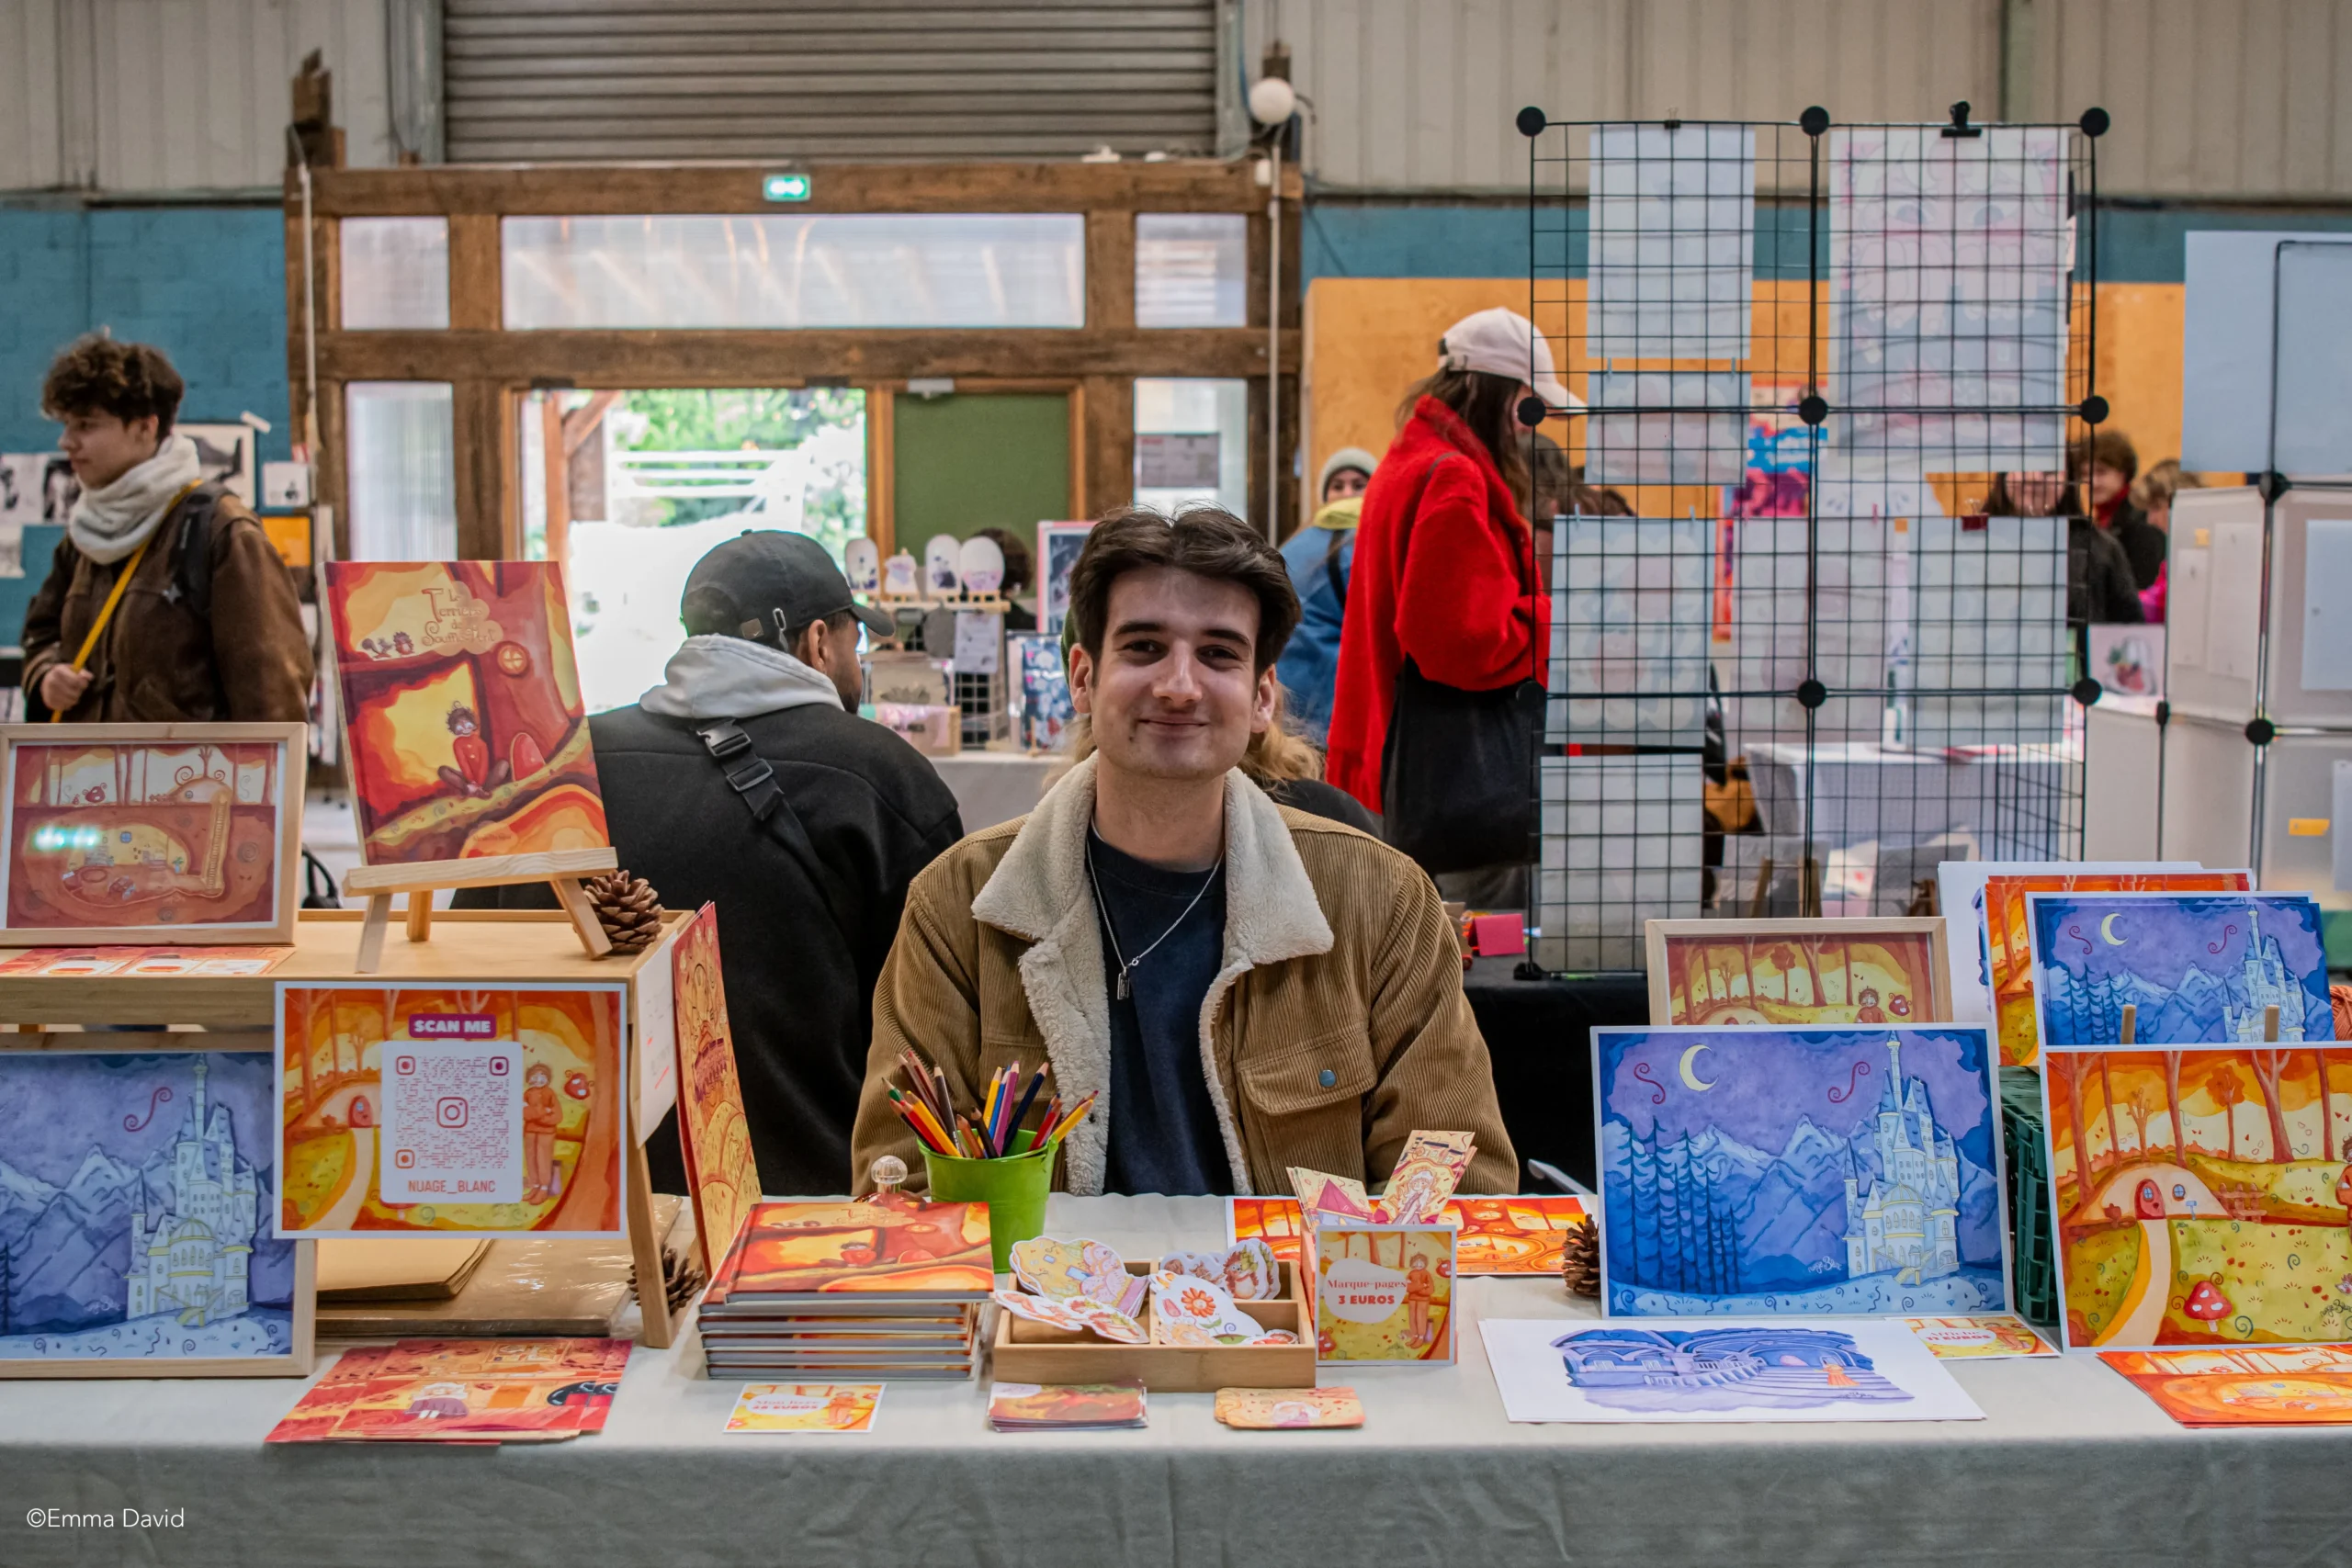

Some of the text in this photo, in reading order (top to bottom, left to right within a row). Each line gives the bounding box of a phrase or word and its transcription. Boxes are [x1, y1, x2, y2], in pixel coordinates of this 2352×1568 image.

[414, 1020, 491, 1032] SCAN ME
[408, 1179, 496, 1194] NUAGE_BLANC
[1328, 1280, 1407, 1290] Marque-pages
[1338, 1295, 1395, 1304] 3 EUROS
